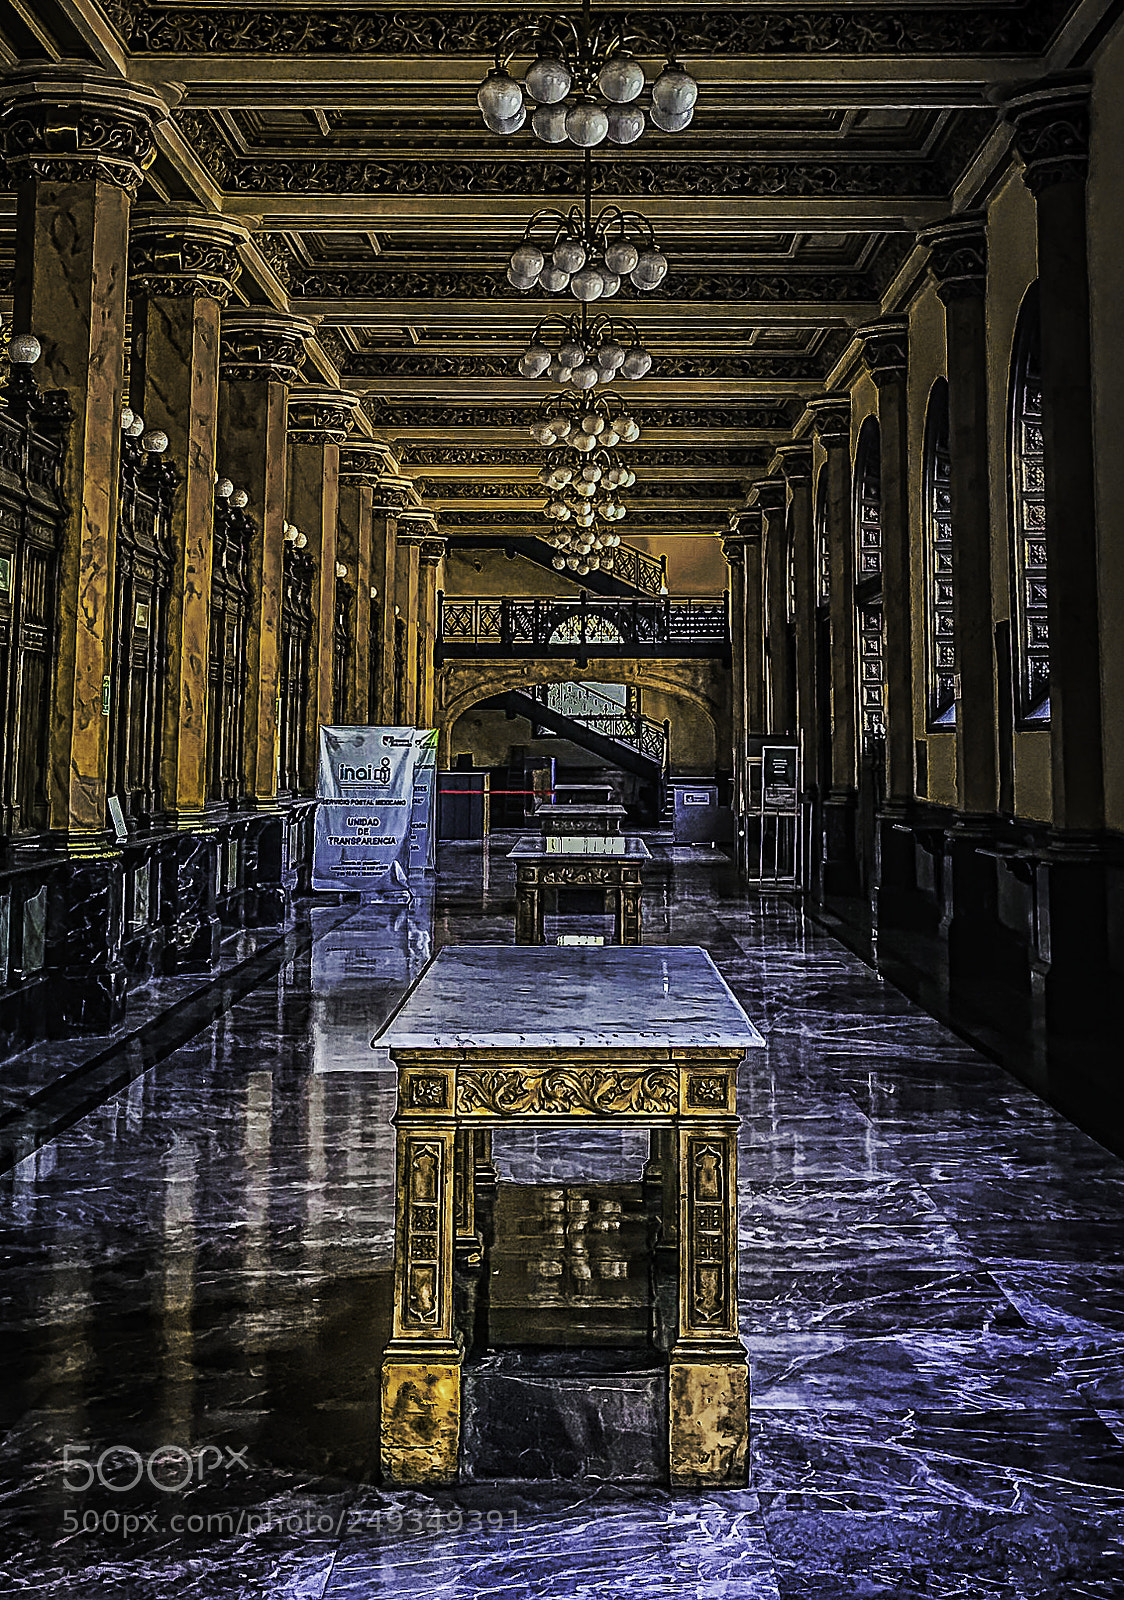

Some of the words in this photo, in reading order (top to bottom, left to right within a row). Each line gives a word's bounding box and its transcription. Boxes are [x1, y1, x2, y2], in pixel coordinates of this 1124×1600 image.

[339, 763, 373, 781] inai
[347, 817, 380, 827] UNIDAD
[357, 827, 370, 836] DE
[327, 836, 397, 846] TRANSPARENCIA
